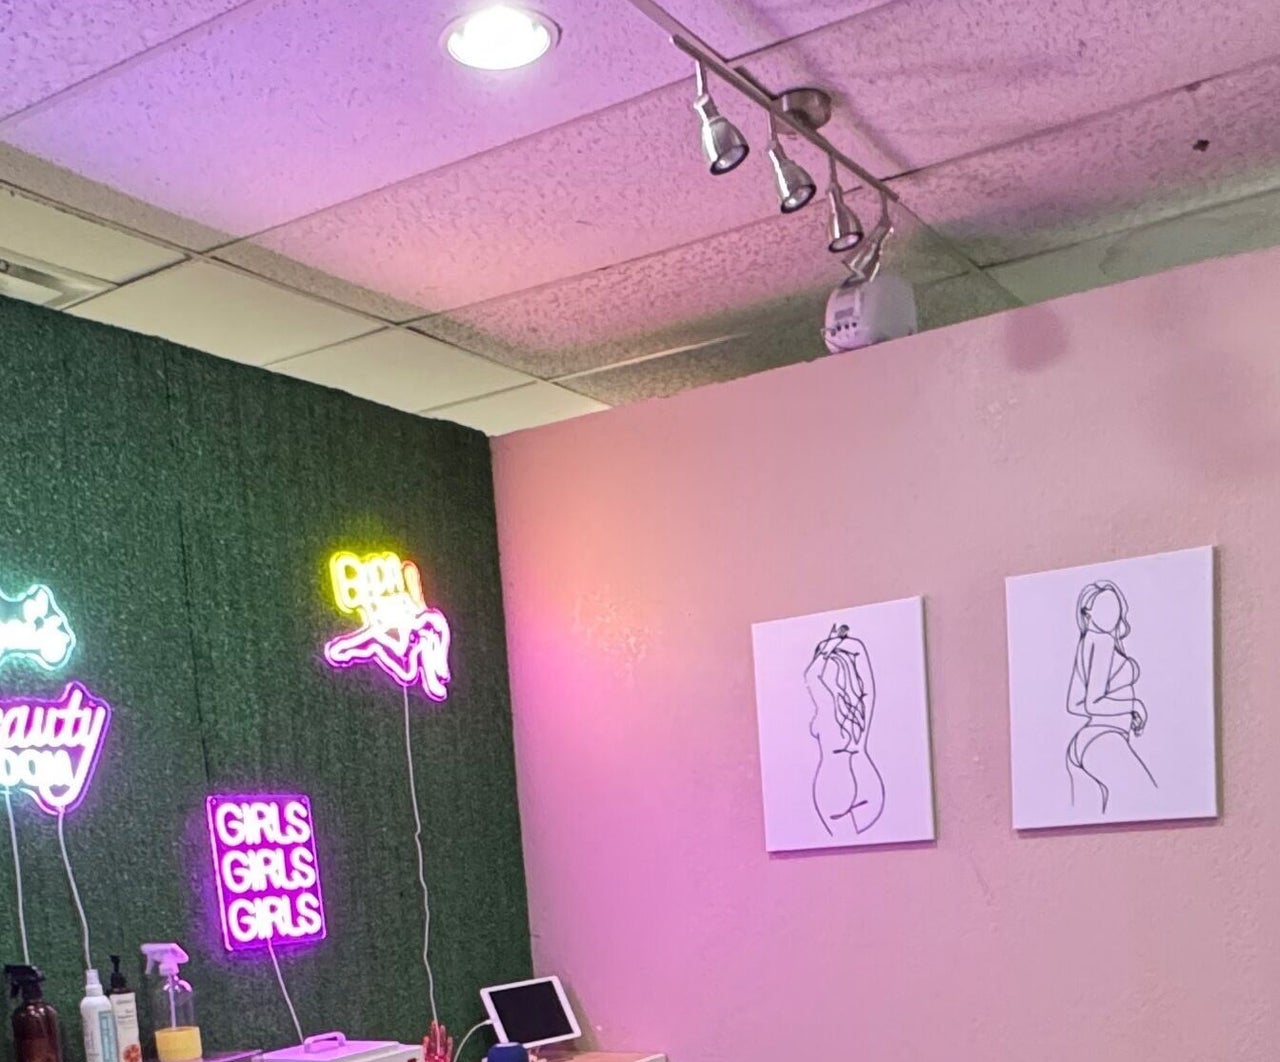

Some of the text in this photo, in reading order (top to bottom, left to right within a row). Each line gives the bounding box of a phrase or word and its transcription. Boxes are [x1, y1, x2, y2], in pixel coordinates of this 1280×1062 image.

[215, 800, 312, 847] GIRLS
[221, 846, 317, 894] GIRLS
[227, 892, 322, 942] GIRLS
